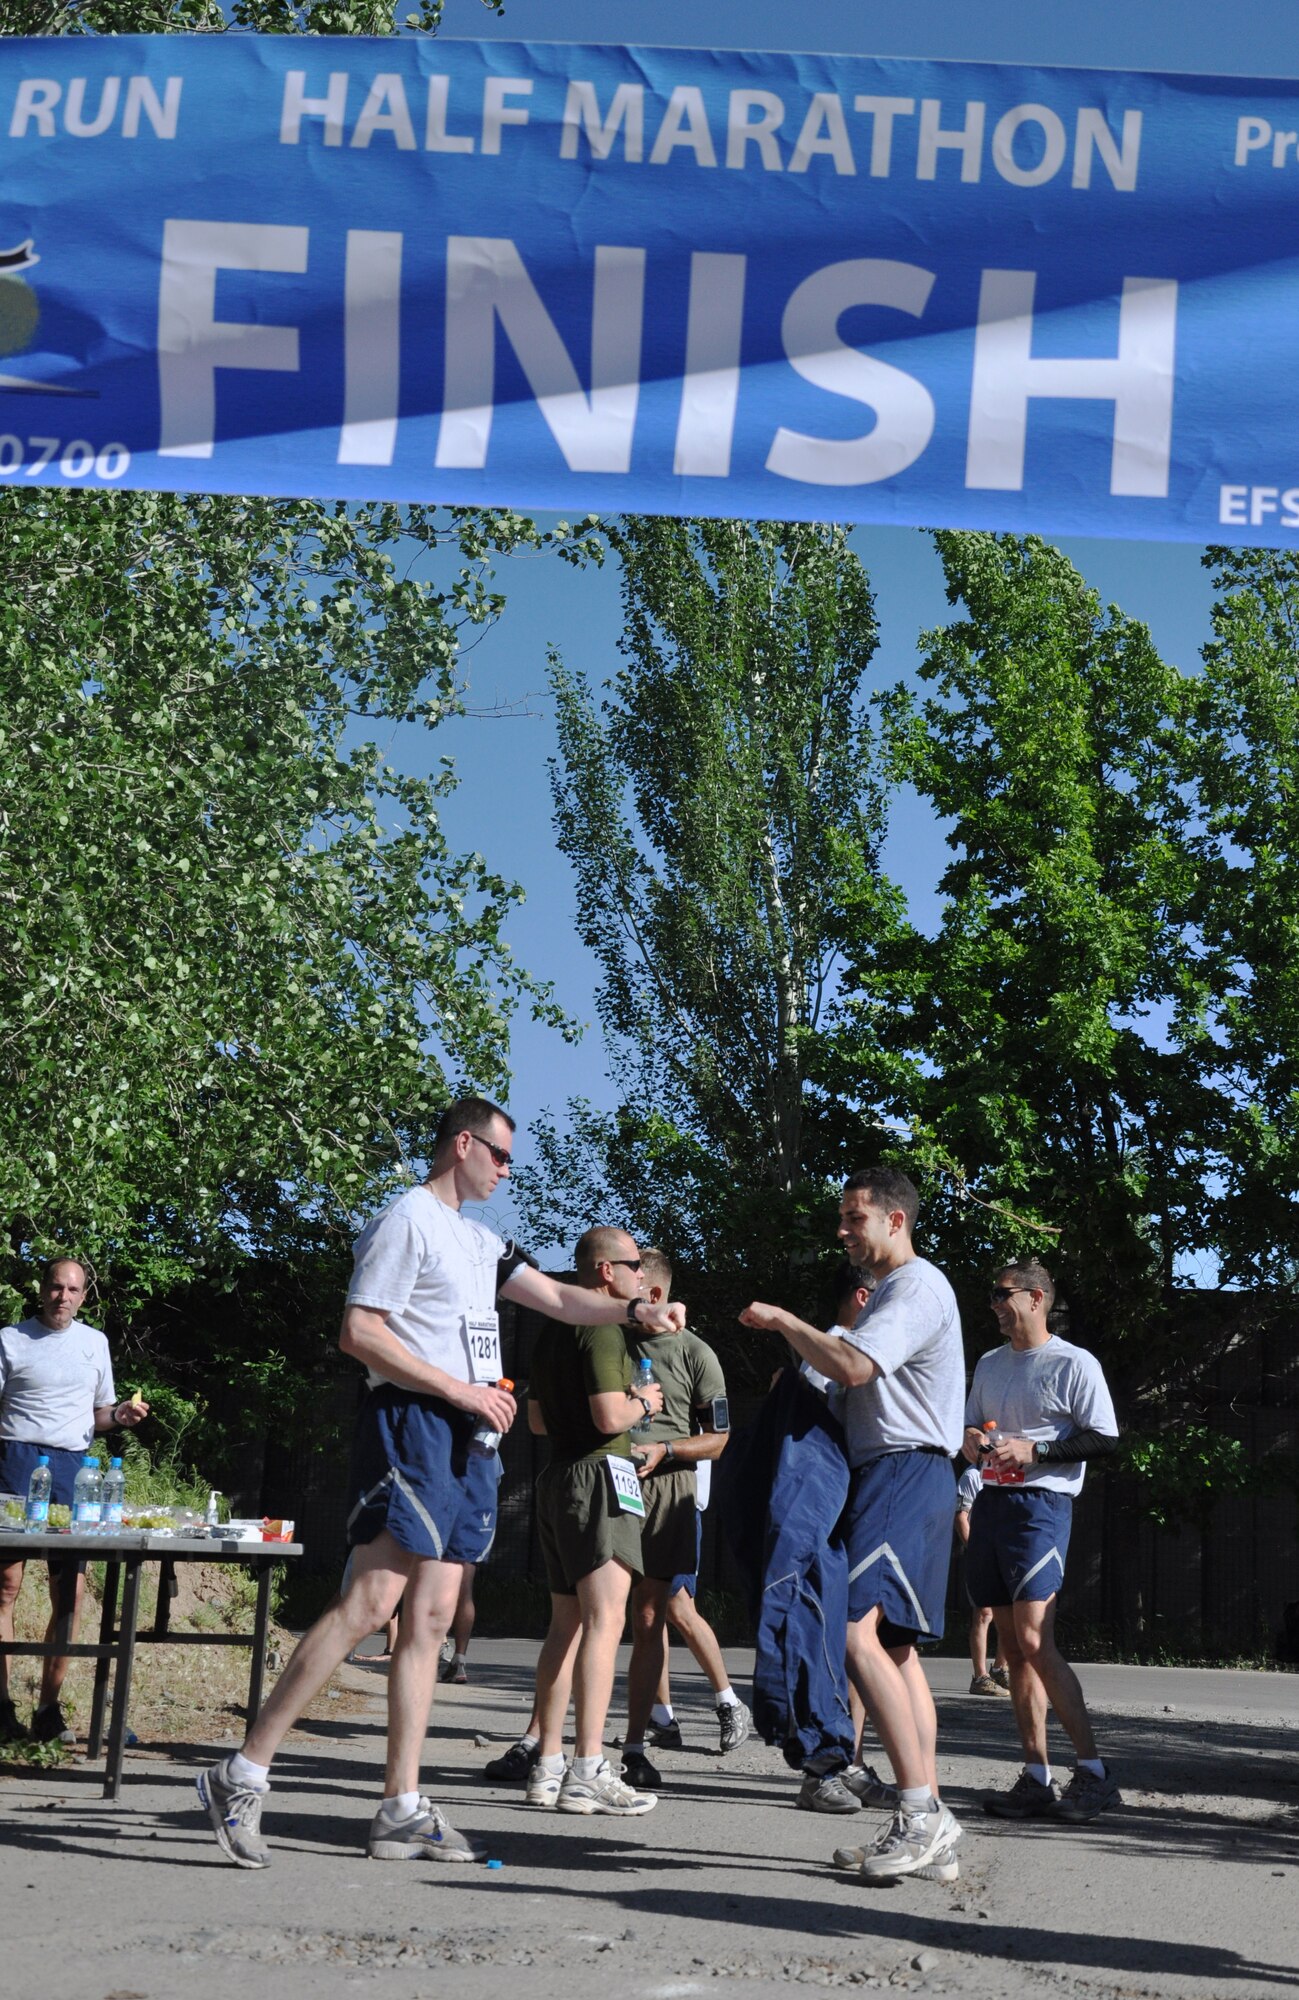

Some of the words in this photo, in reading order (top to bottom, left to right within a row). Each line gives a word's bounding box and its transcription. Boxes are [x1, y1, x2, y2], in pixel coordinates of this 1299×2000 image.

[9, 76, 183, 140] RUN
[279, 70, 534, 156] HALF
[559, 81, 1143, 192] MARATHON
[1234, 116, 1299, 168] Pr
[157, 218, 1178, 498] FINISH
[0, 434, 131, 480] 0700
[1219, 484, 1299, 528] EFS
[471, 1335, 497, 1360] 1281
[615, 1473, 640, 1497] 1192
